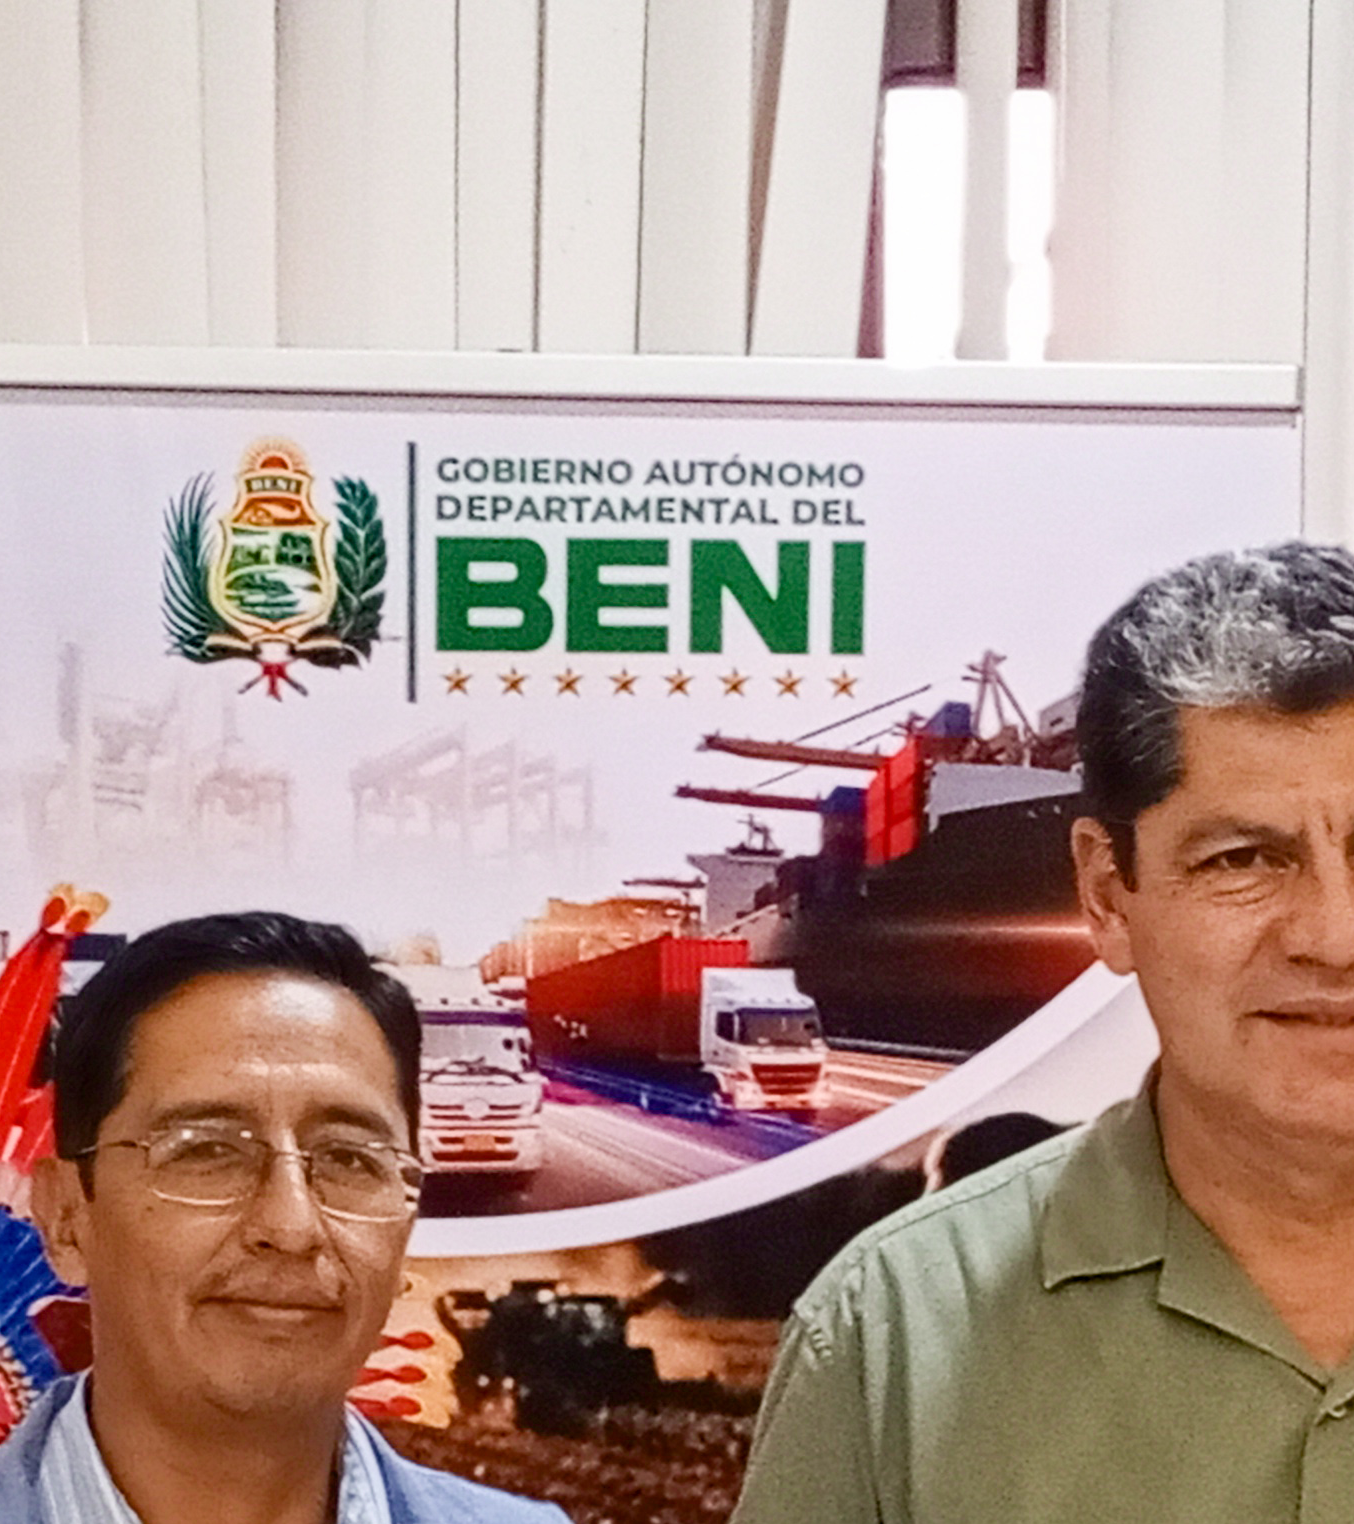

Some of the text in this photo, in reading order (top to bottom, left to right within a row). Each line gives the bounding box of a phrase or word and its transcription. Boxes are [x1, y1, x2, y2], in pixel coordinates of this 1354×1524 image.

[249, 477, 299, 494] BENI
[436, 452, 866, 489] GOBIERNO AUTÓNOMO
[435, 495, 866, 527] DEPARTAMENTAL DEL
[435, 536, 867, 656] BENI
